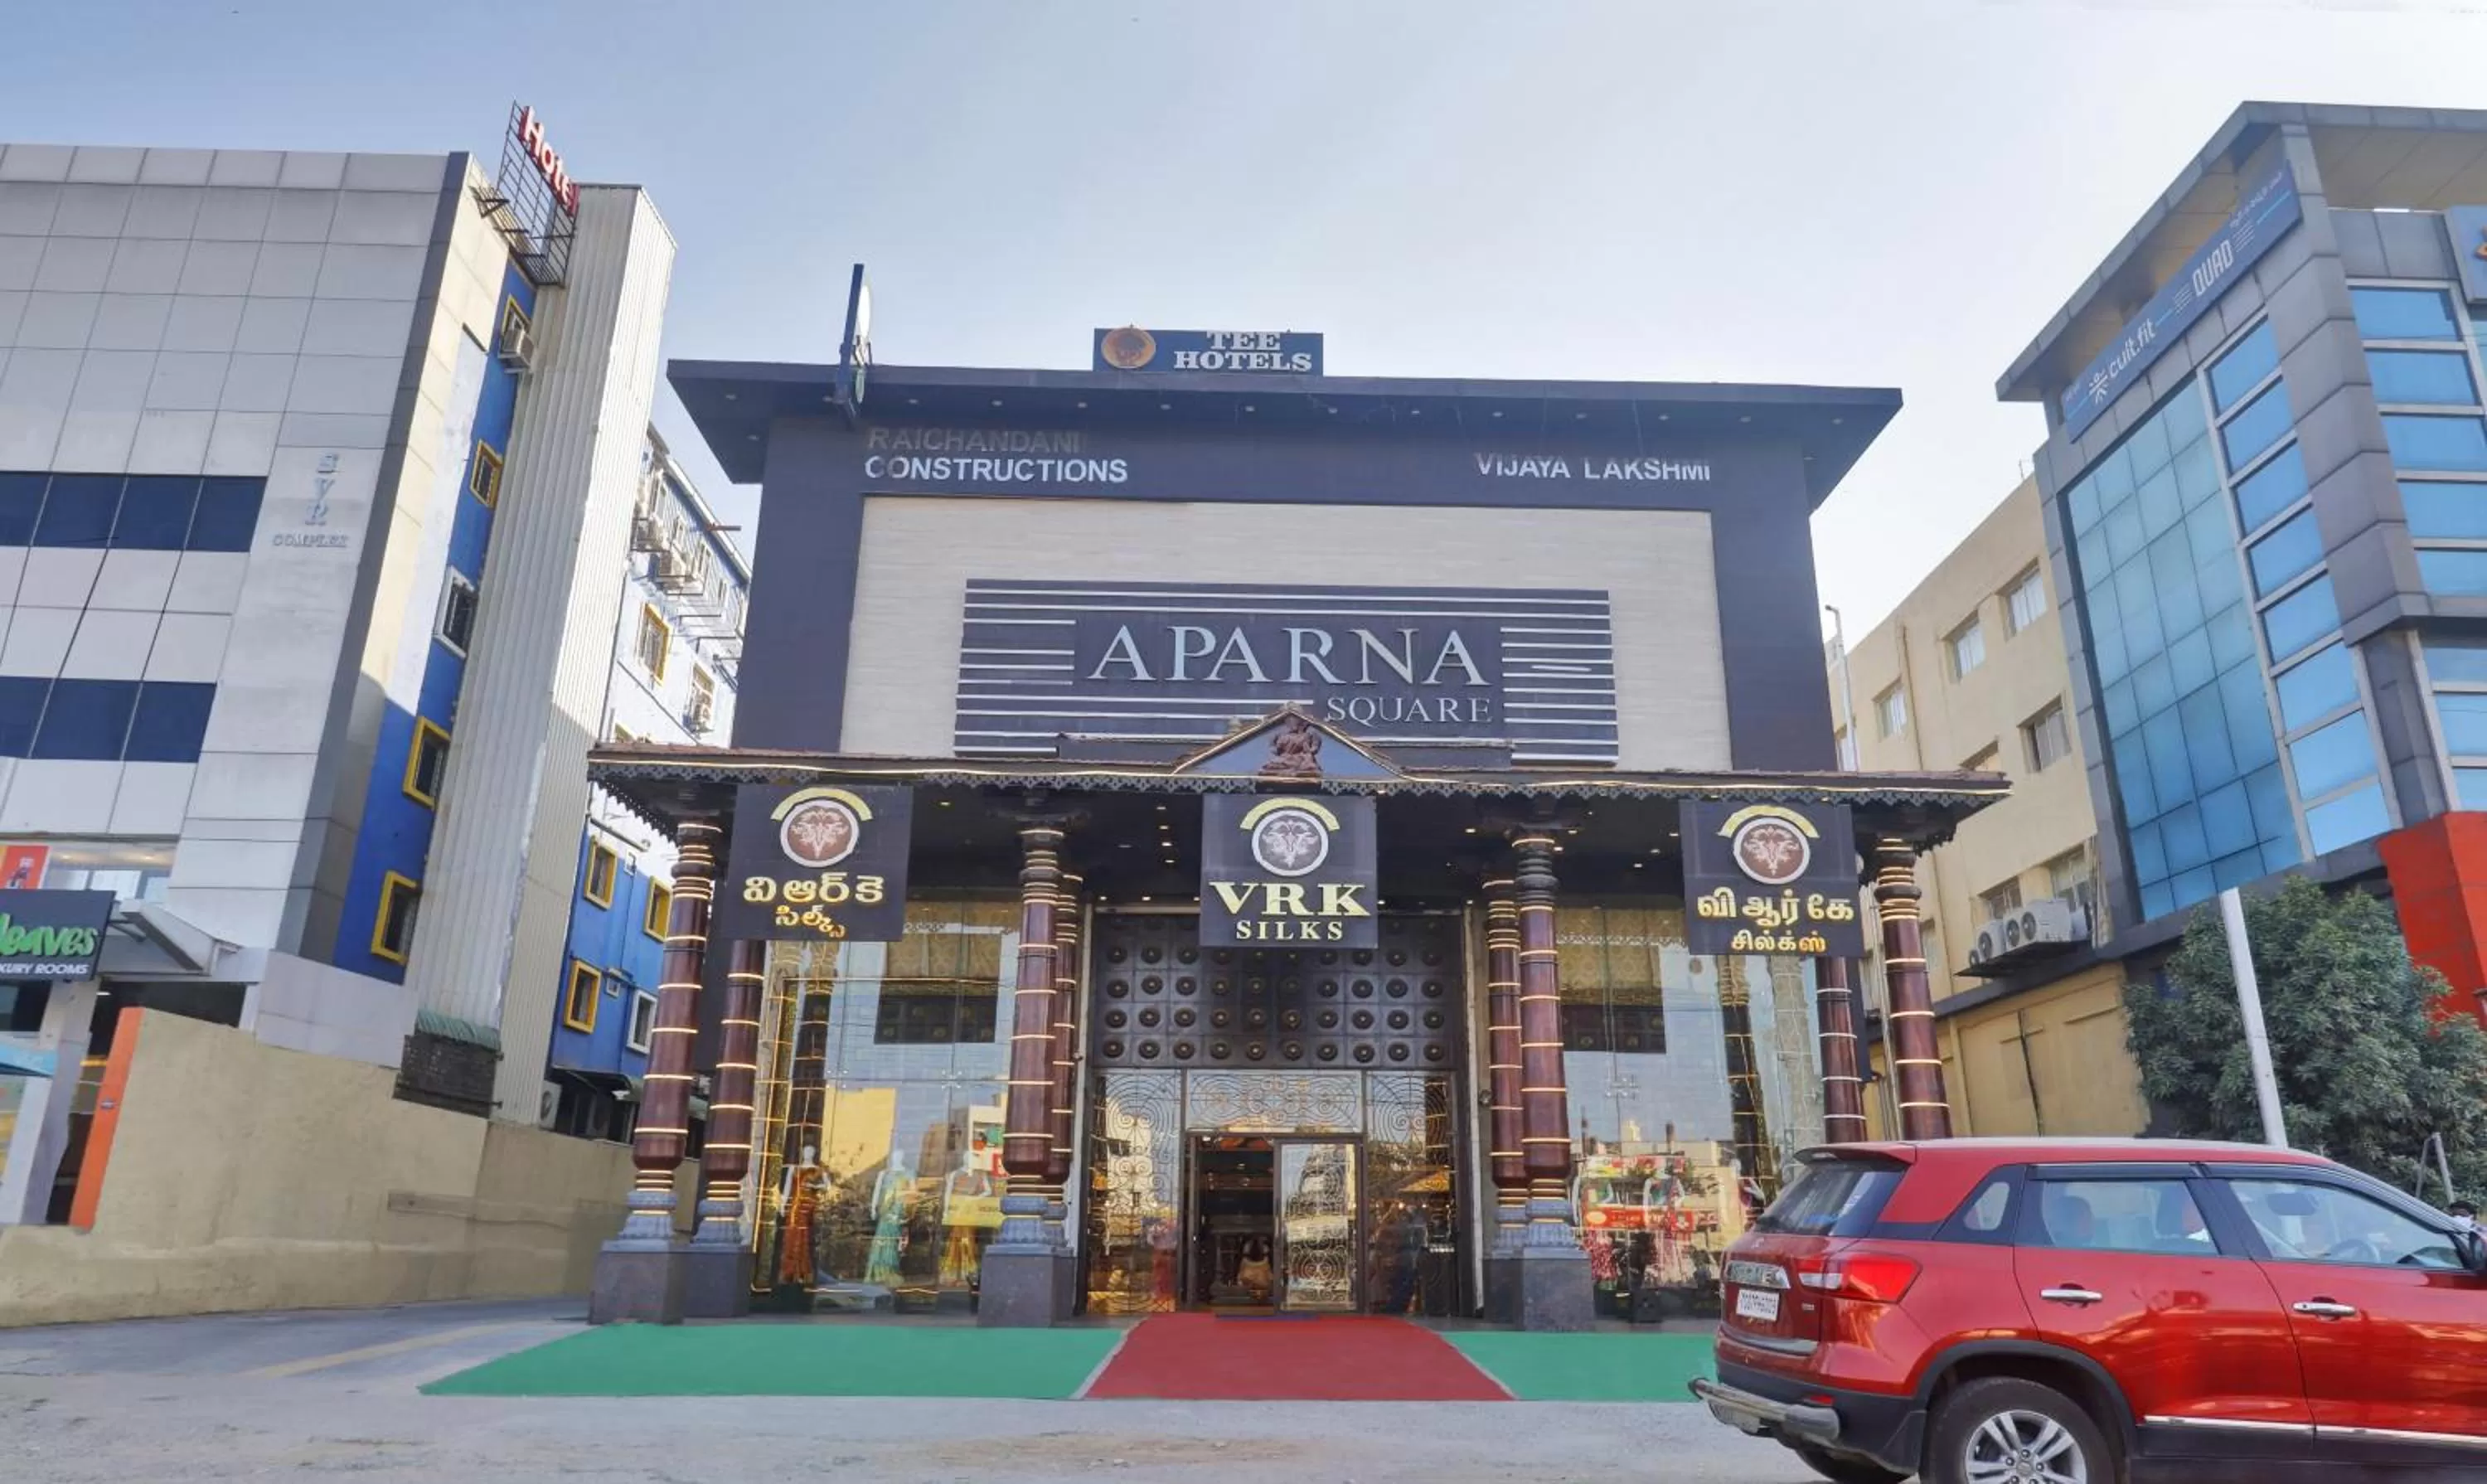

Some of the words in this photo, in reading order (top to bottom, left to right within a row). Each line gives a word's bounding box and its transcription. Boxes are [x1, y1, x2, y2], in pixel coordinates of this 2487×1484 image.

[518, 105, 579, 217] Hotel
[2109, 318, 2156, 379] cult.fit
[2192, 239, 2234, 297] QUAD
[1206, 331, 1280, 350] TEE
[1173, 351, 1312, 371] HOTELS
[868, 427, 1084, 453] RAICHANDANI
[865, 456, 1128, 483] CONSTRUCTIONS
[1476, 453, 1571, 478] VIJAYA
[1583, 457, 1710, 481] LAKSHMI
[1087, 624, 1491, 686] APARNA
[1324, 696, 1492, 727] SQUARE
[1209, 881, 1371, 916] VRK
[1236, 919, 1343, 941] SILKS
[34, 963, 90, 975] ROOMS
